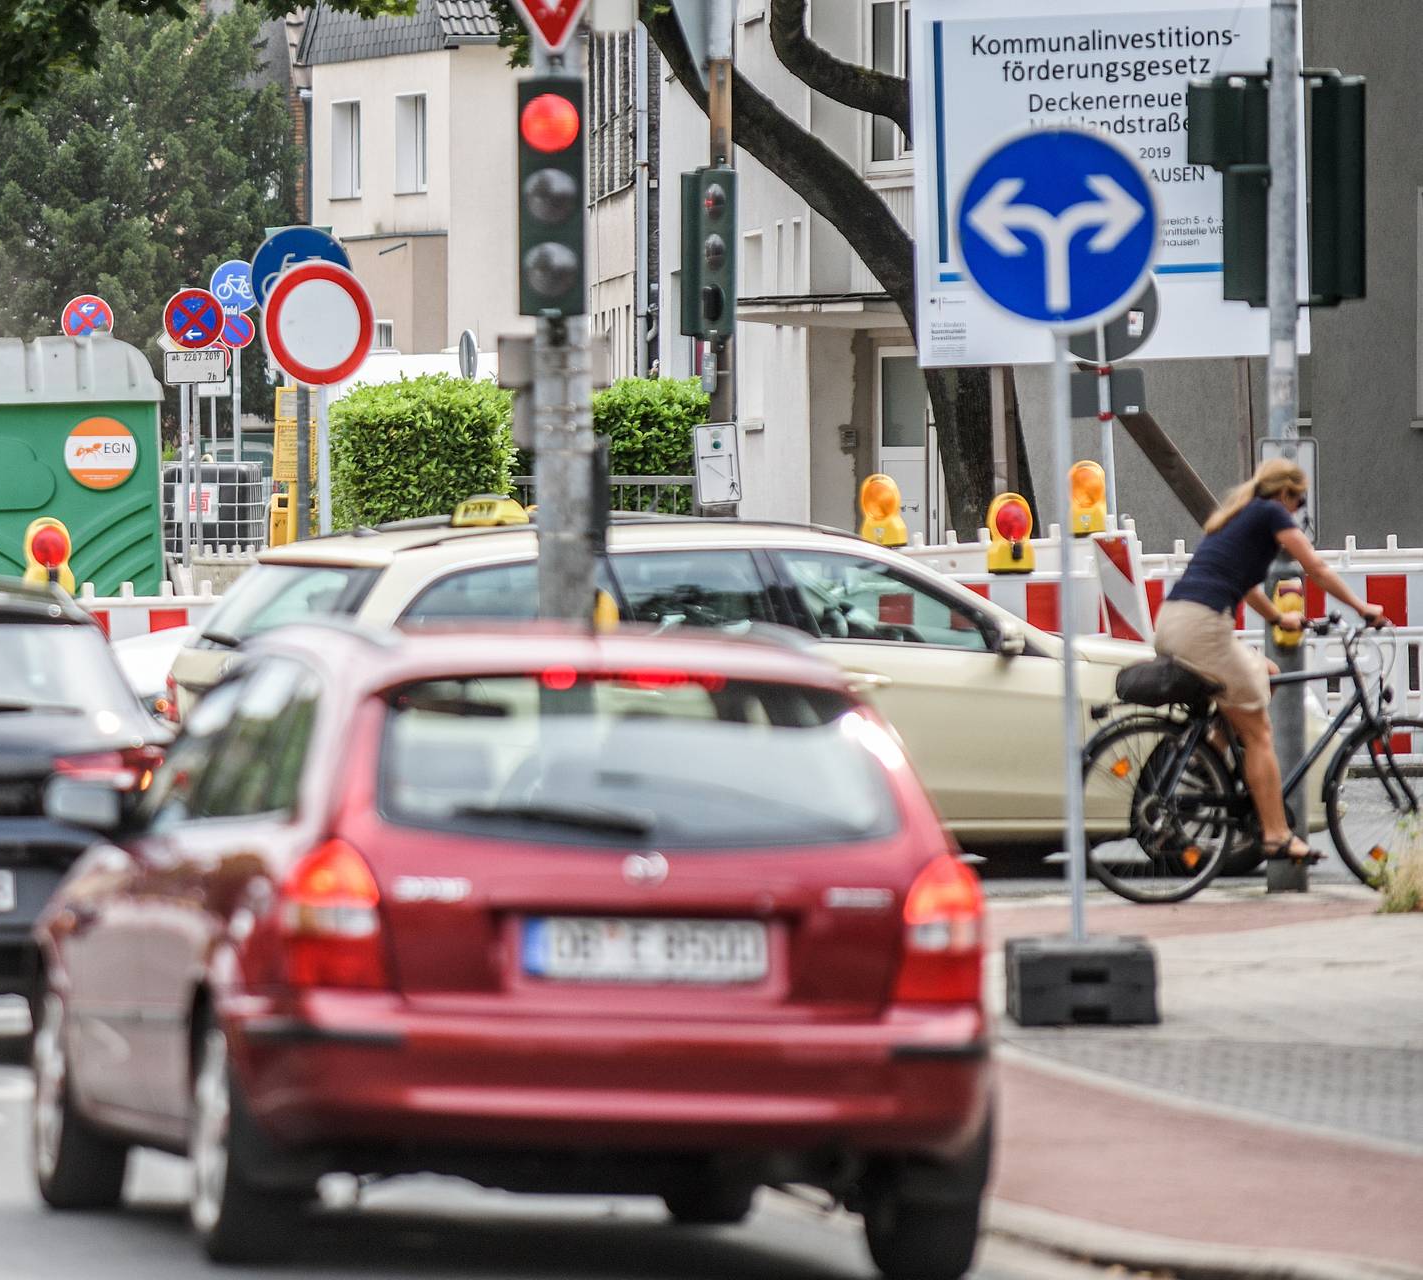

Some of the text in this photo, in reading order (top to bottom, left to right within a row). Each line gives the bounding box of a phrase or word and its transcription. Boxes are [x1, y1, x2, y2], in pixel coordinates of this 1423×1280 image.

[971, 27, 1241, 56] Kommunalinvestitions-
[1002, 55, 1211, 83] förderungsgesetz
[1139, 147, 1171, 159] 2019
[104, 442, 131, 454] EGN
[549, 923, 602, 964] OB
[662, 923, 760, 964] 8500
